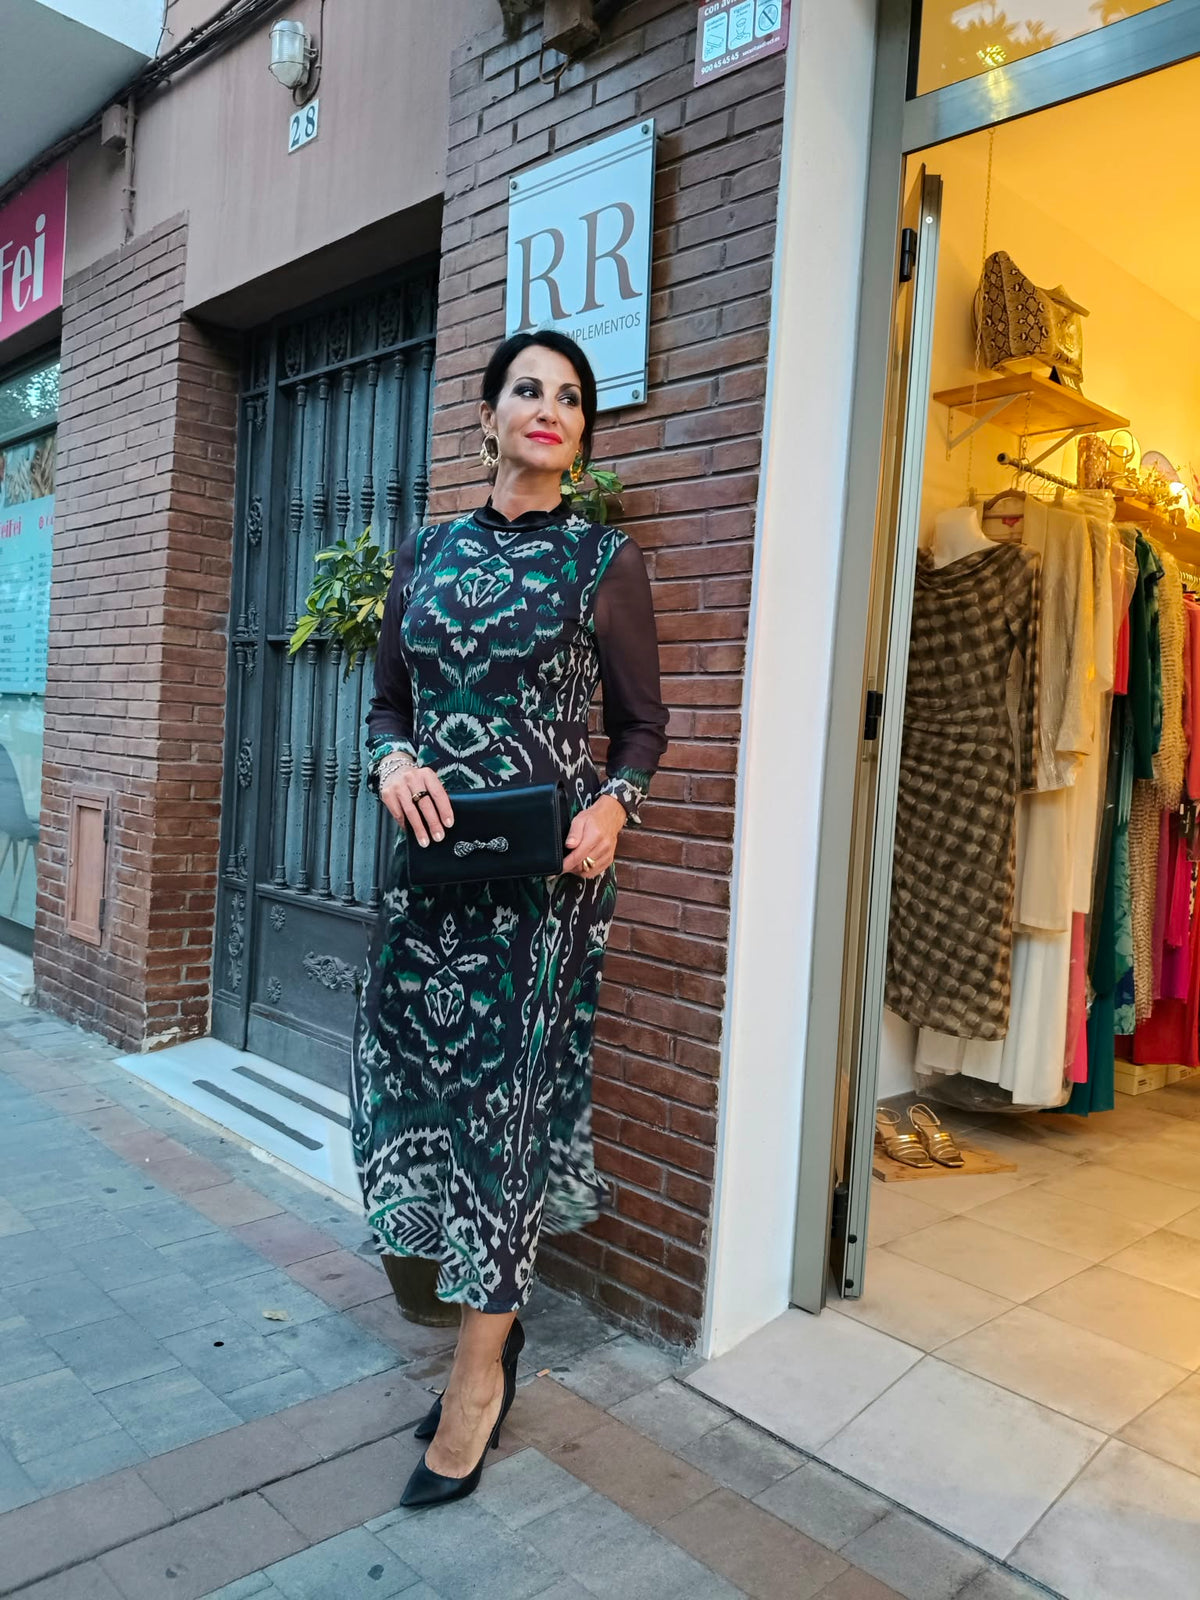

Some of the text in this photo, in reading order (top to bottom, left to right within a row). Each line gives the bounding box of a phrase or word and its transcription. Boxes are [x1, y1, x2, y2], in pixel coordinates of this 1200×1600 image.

[704, 3, 720, 16] con
[701, 63, 714, 75] 900
[713, 59, 722, 68] 45
[722, 55, 731, 65] 45
[730, 51, 739, 61] 45
[291, 105, 316, 149] 28
[512, 202, 643, 334] RR
[563, 311, 641, 343] MPLEMENTOS
